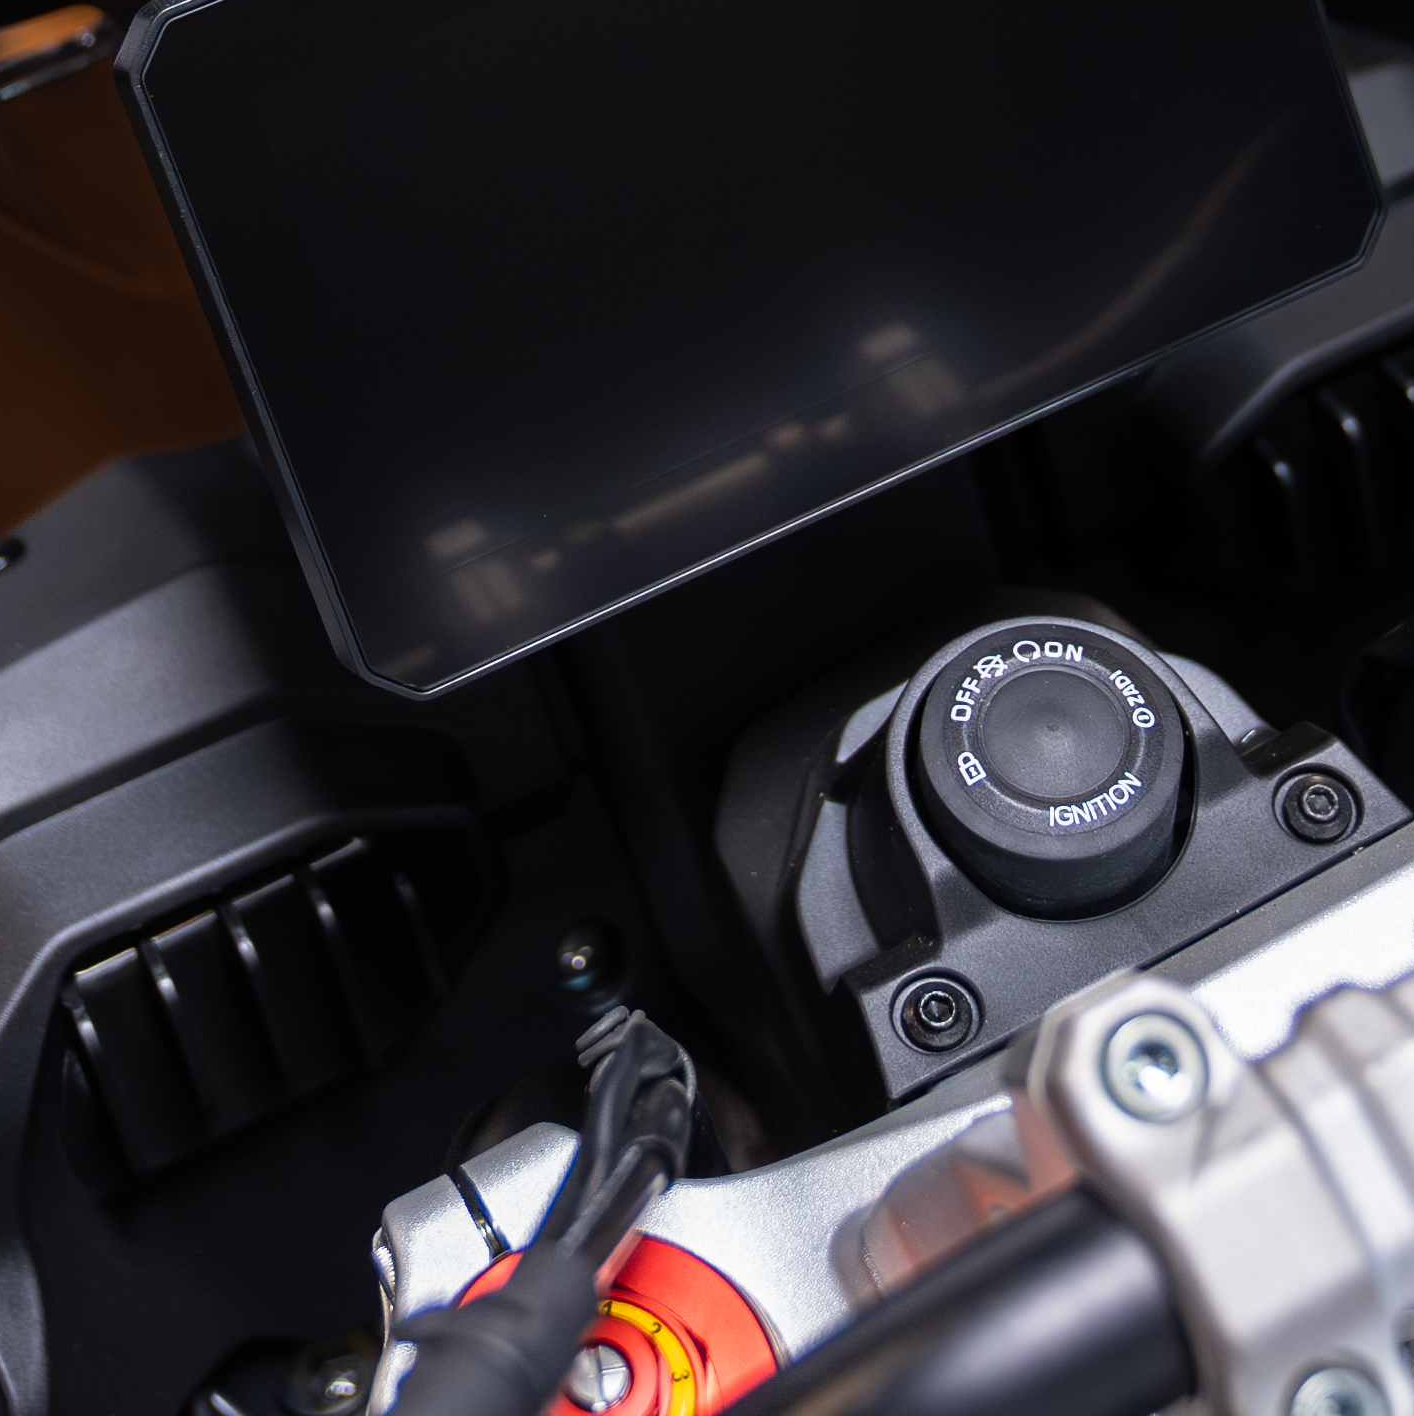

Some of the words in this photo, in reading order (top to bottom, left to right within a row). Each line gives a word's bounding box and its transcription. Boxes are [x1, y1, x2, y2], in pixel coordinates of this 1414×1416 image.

[1044, 641, 1084, 662] ON
[950, 676, 981, 722] OFF
[1108, 669, 1146, 708] ZADI
[1049, 770, 1142, 827] IGNITION
[671, 1369, 690, 1383] 3
